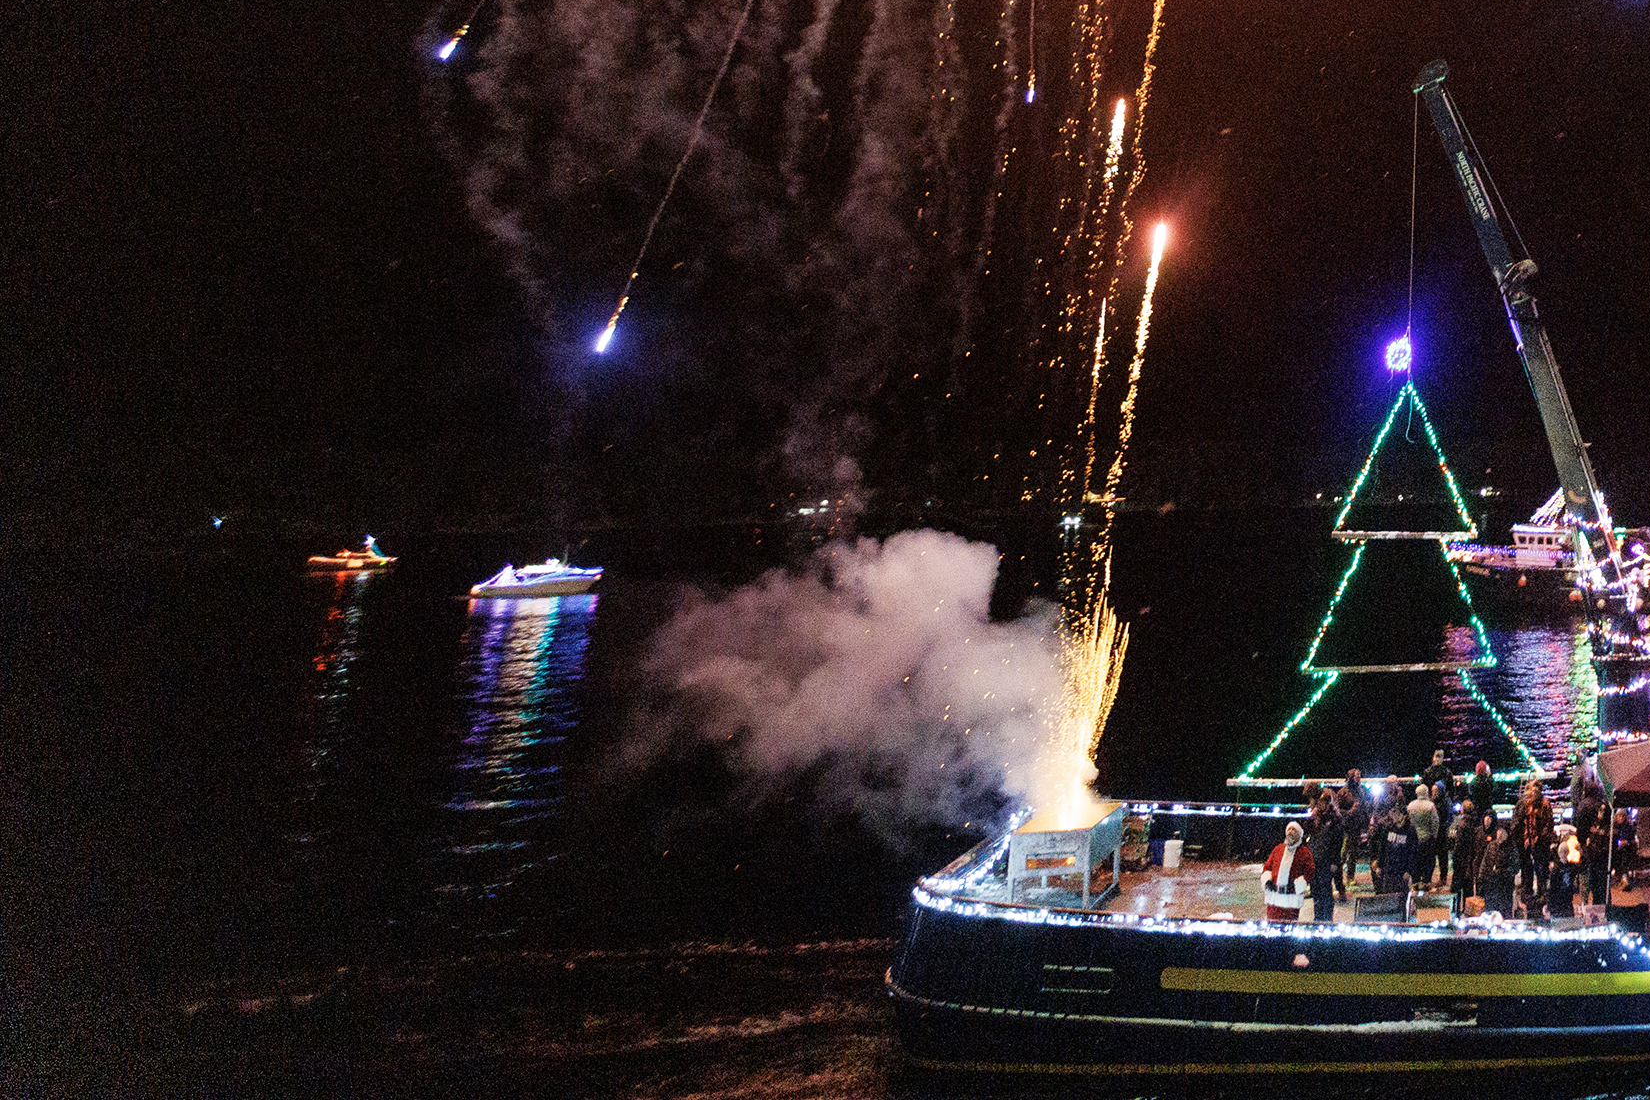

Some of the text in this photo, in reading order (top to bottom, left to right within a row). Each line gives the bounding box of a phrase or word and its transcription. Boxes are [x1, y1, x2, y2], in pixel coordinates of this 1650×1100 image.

[1456, 151, 1472, 175] NORTH
[1465, 173, 1482, 199] PACIFIC
[1475, 197, 1491, 220] CRANE
